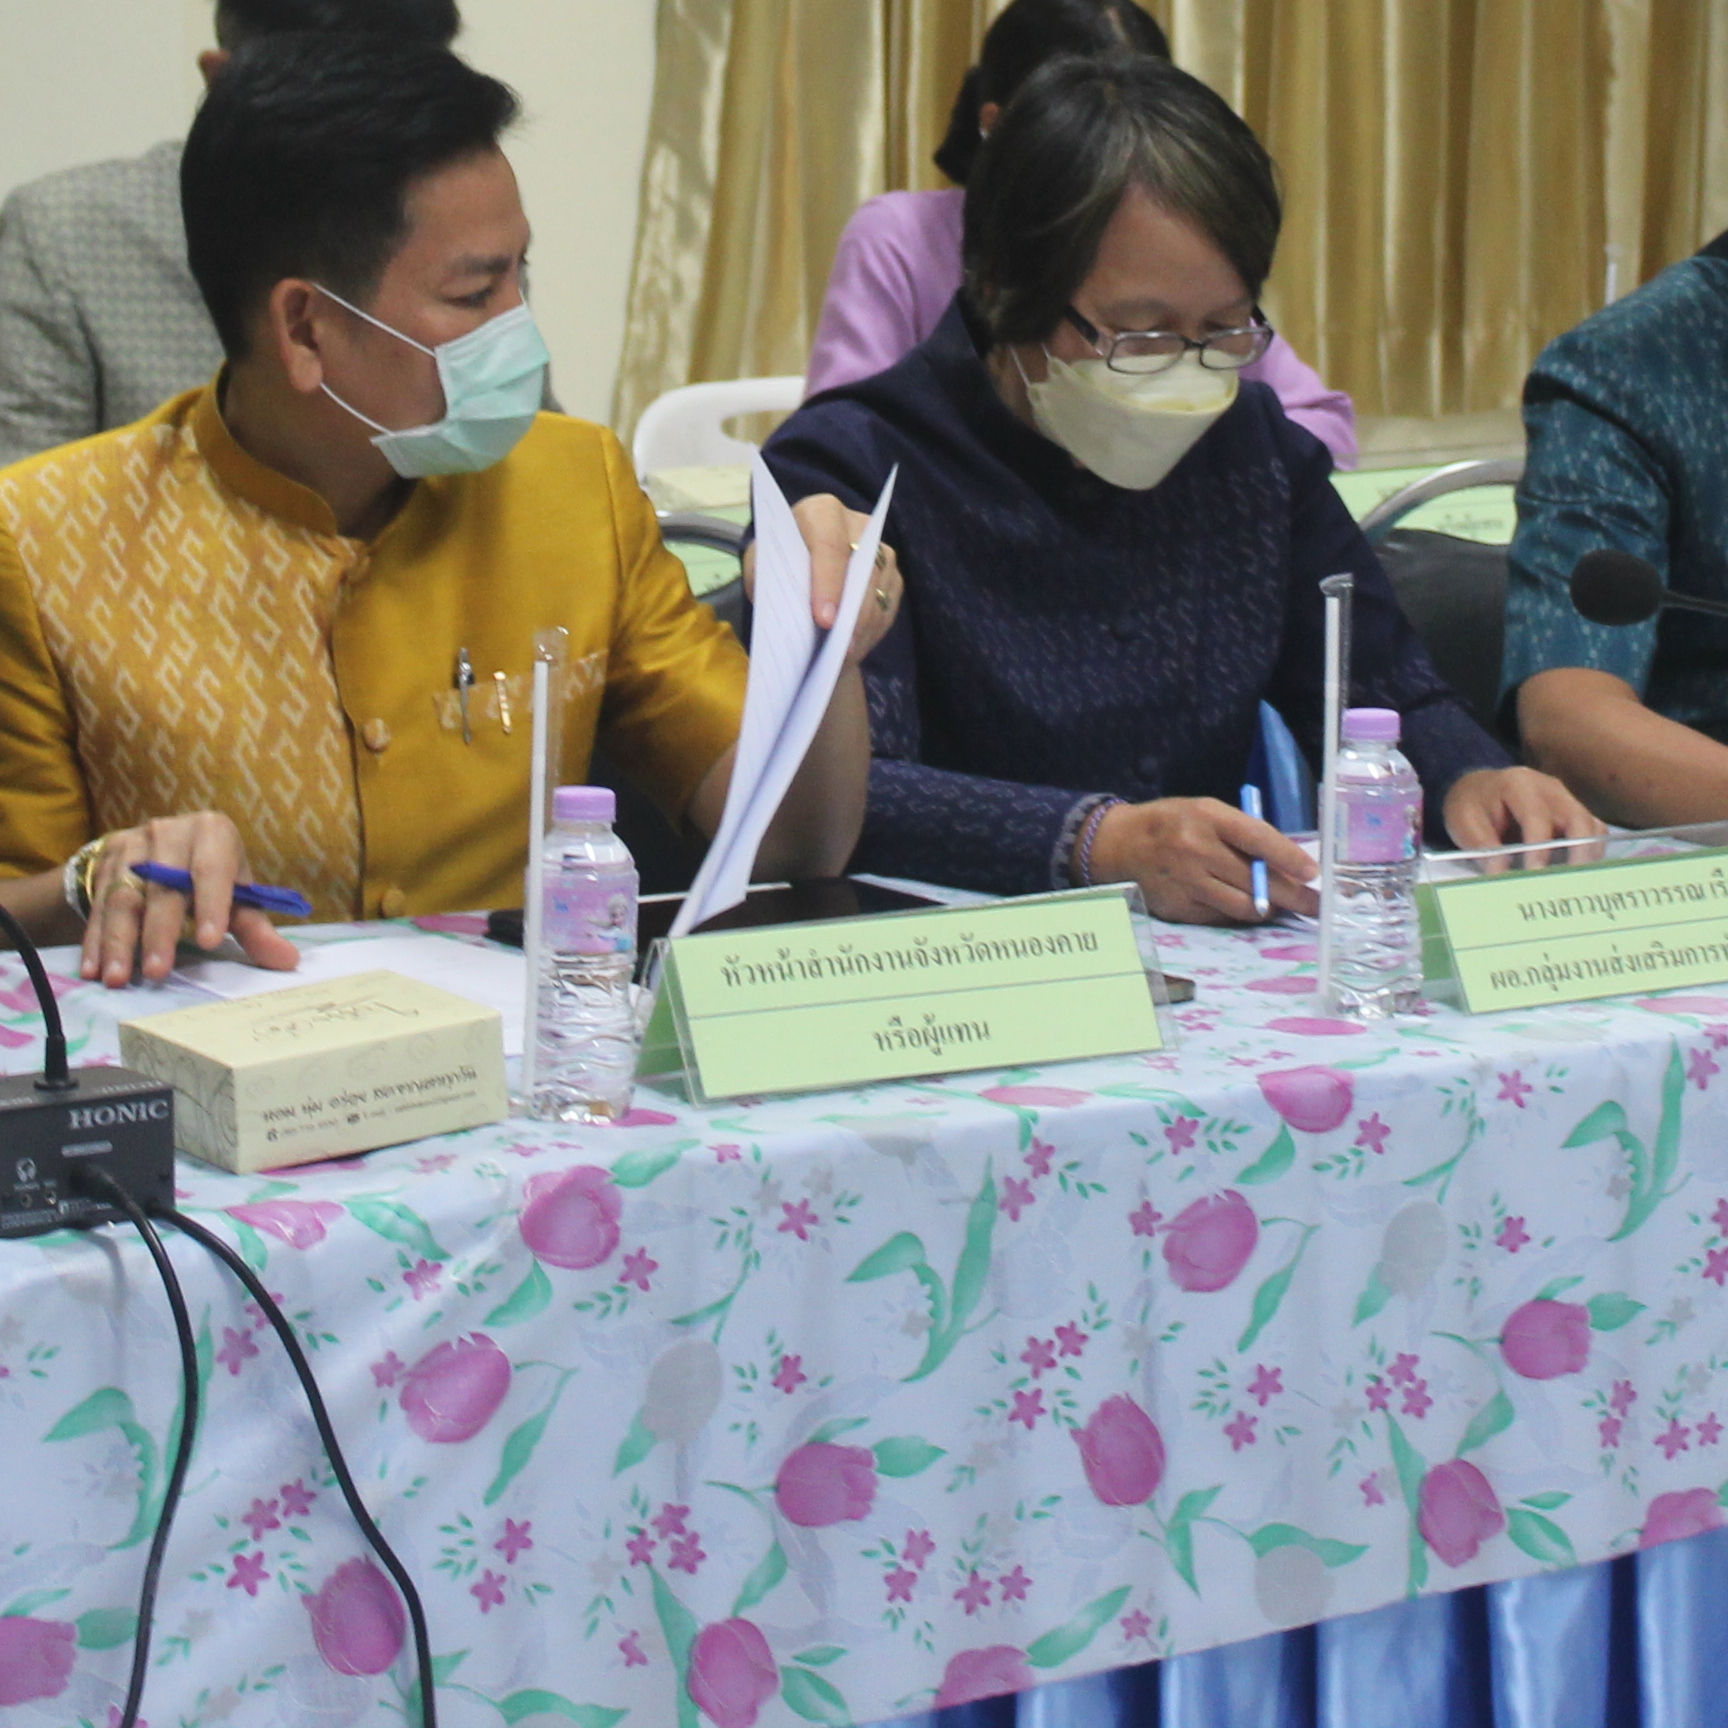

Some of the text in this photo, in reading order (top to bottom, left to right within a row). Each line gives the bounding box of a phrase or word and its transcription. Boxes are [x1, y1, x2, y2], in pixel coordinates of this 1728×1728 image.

[719, 929, 1100, 987] หัวหน้าสำนักงานจังหวัดหนองคาย
[872, 1013, 993, 1058] หรือผู้แทน
[68, 1099, 169, 1129] HONIC
